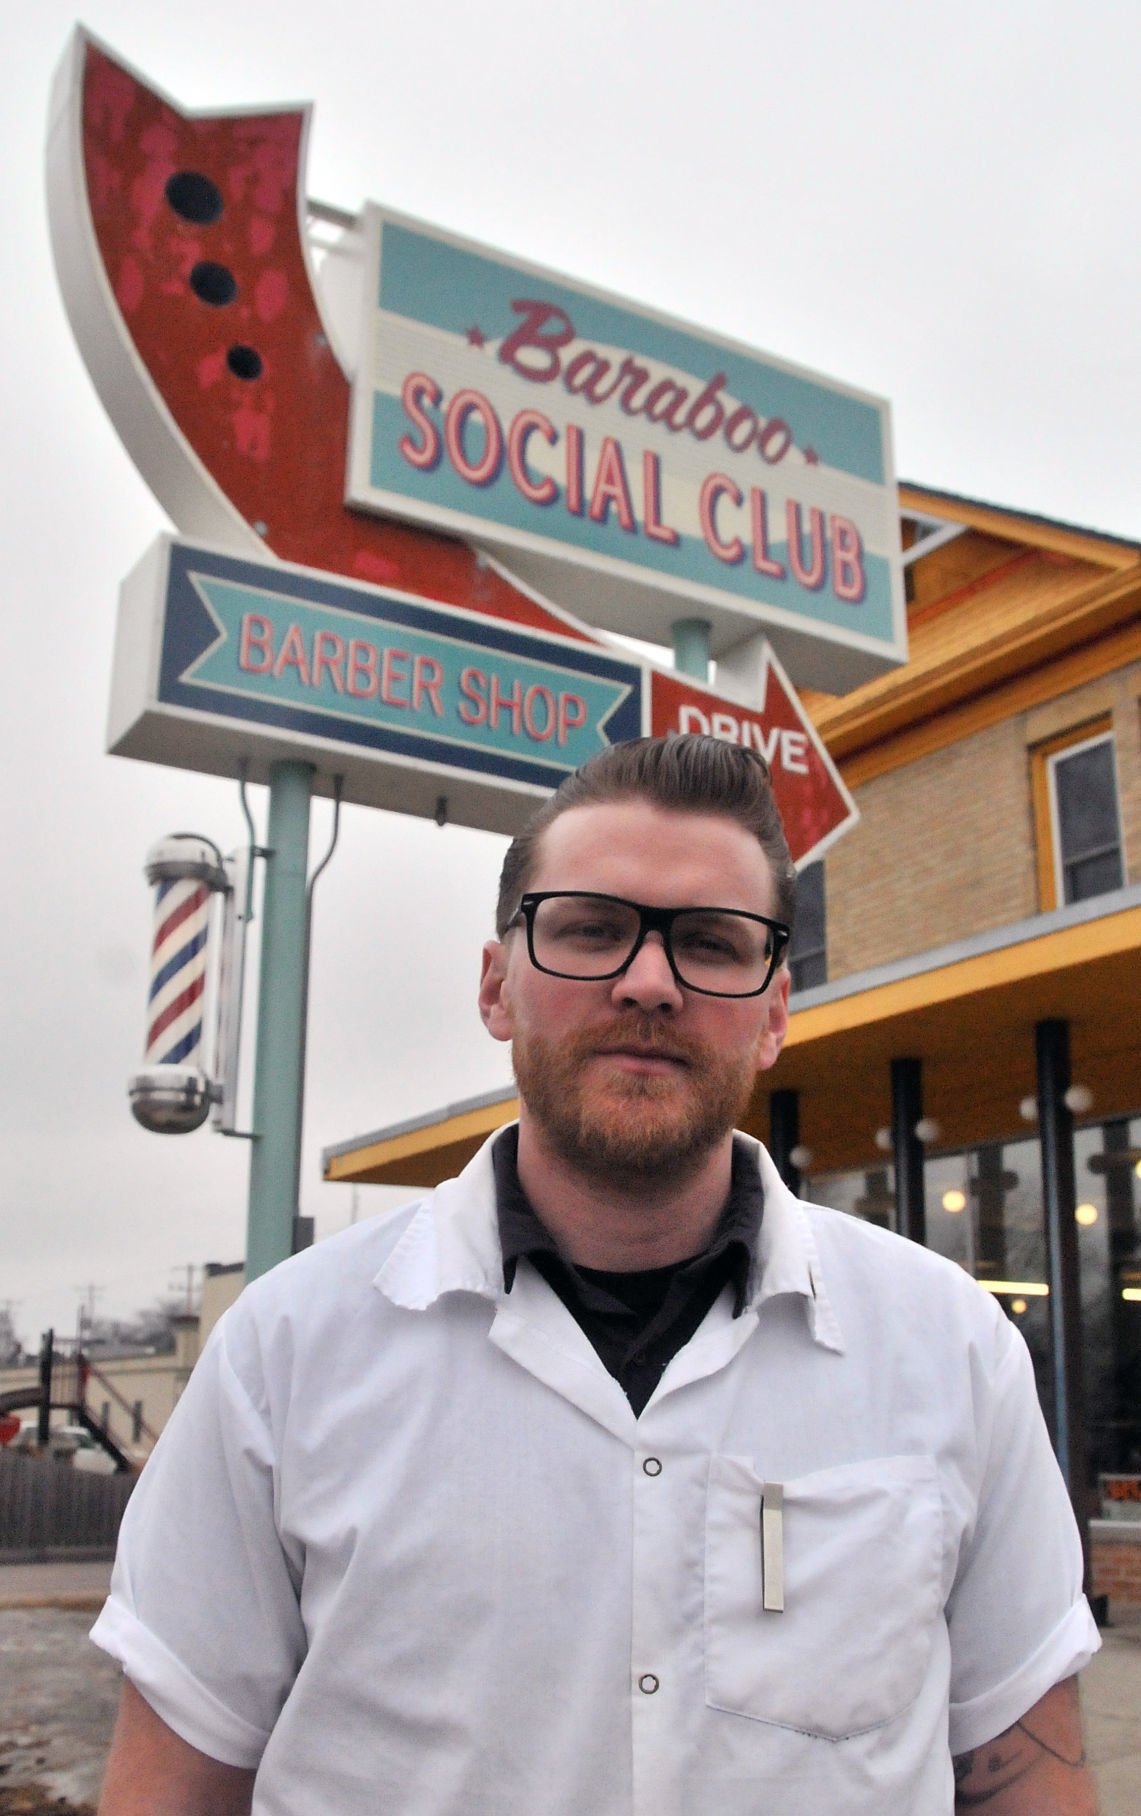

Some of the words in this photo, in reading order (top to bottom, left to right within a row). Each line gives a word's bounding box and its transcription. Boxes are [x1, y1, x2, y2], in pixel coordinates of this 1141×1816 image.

[499, 299, 793, 464] Baraboo
[400, 372, 680, 546] SOCIAL
[700, 472, 866, 603] CLUB
[237, 611, 445, 718] BARBER
[457, 667, 588, 746] SHOP
[678, 704, 809, 774] DRIVE
